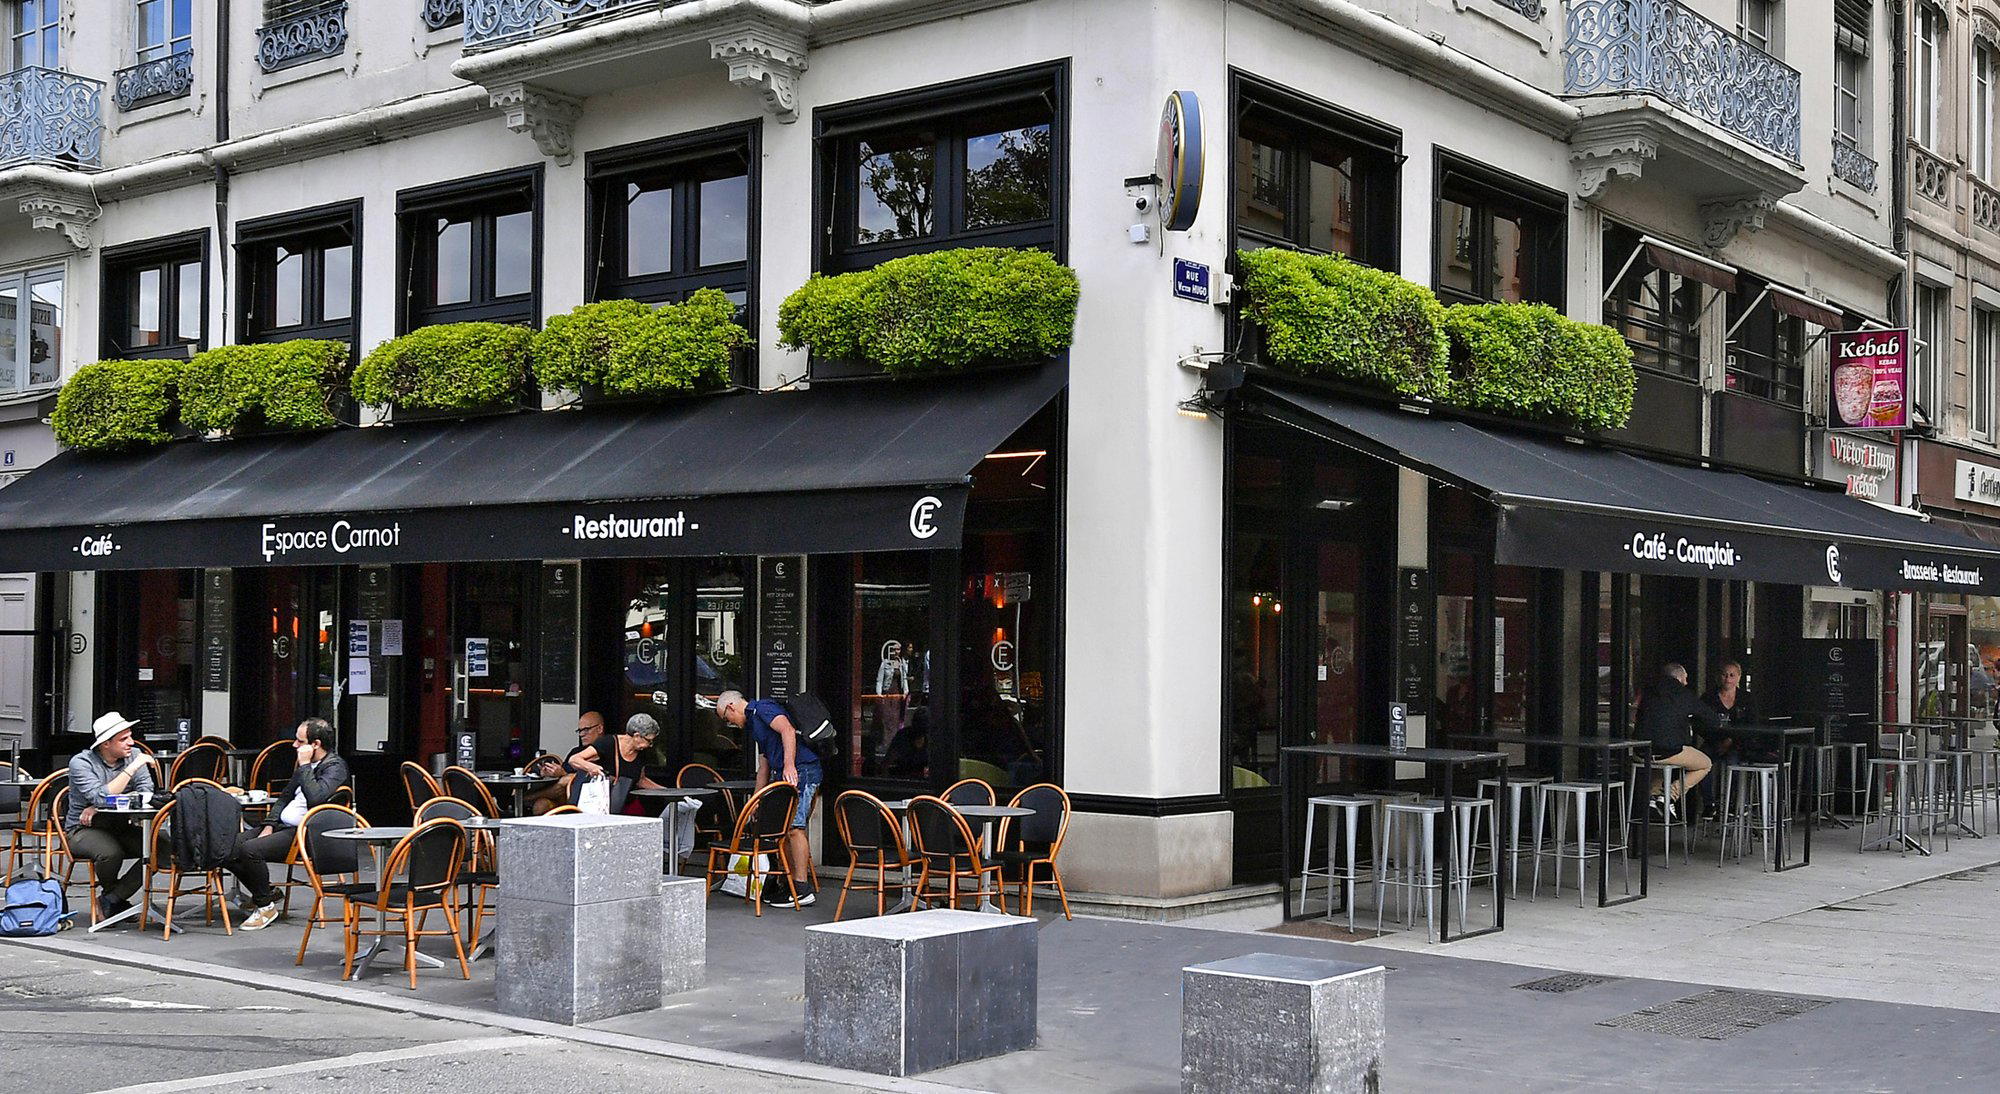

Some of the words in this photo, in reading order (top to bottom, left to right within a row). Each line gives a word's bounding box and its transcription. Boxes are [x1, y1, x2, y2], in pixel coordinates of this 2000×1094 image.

[1186, 270, 1199, 282] RUE
[1192, 284, 1207, 297] HUGO
[1839, 337, 1900, 358] Kebab
[1831, 436, 1865, 464] Victor
[1866, 445, 1896, 479] Hugo
[1848, 474, 1879, 498] Kebab
[574, 511, 685, 539] Restaurant
[262, 523, 327, 562] Espace
[331, 520, 401, 553] Carnot
[1632, 532, 1667, 560] Café
[1677, 537, 1735, 570] Comptoir
[1903, 559, 1938, 582] Brasserie
[1943, 563, 1980, 586] Restaurant
